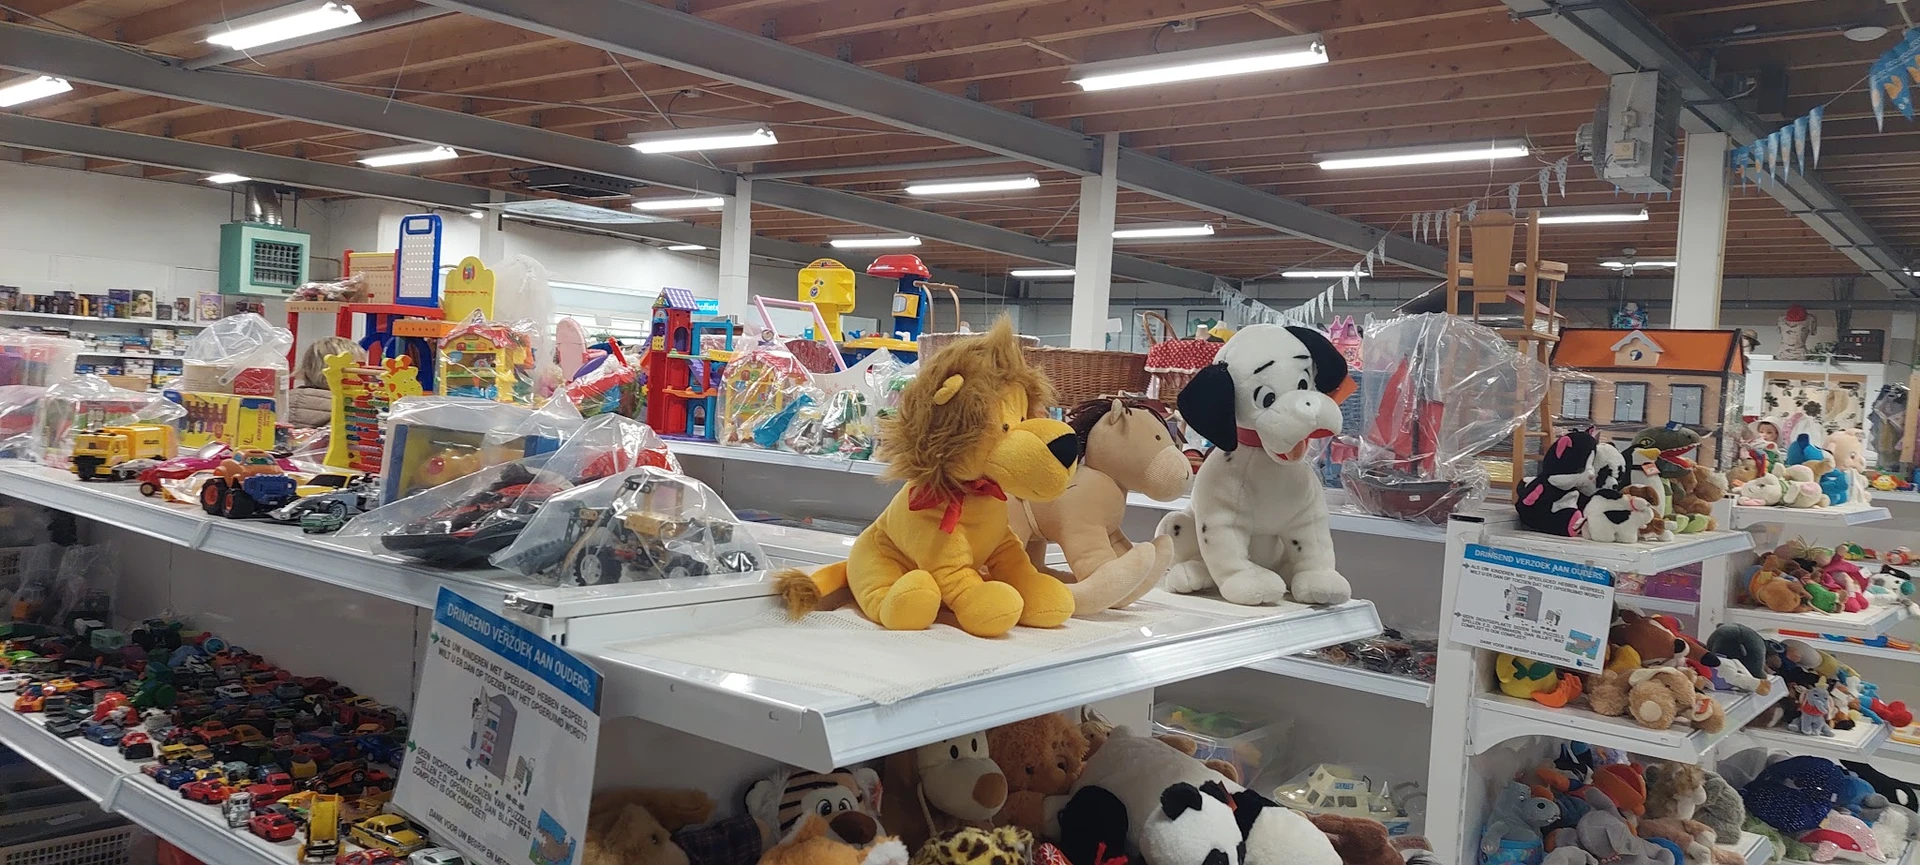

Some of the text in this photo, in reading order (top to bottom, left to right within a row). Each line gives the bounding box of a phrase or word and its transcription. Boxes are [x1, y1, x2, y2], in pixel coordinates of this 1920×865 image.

[1474, 549, 1513, 562] DRINGEND
[1514, 557, 1551, 569] VERZOEK
[1552, 564, 1569, 573] AAN
[440, 634, 451, 648] ALS
[451, 641, 461, 654] UW
[461, 646, 489, 670] KINDEREN
[489, 662, 502, 677] MET
[502, 669, 535, 697] SPEELGOED
[536, 689, 559, 711] HEBBEN
[446, 601, 491, 637] DRINGEND
[490, 624, 533, 659] VERZOEK
[533, 647, 554, 671] AAN
[437, 645, 587, 744] WILT U ER DAN OP TOEZIEN DAT HET OPGERUIMD WORDT?
[412, 763, 439, 790] COMPLEET
[438, 781, 445, 793] IS
[445, 786, 457, 801] OOK
[414, 754, 437, 777] SPELLEN
[484, 801, 496, 817] DAN
[517, 824, 531, 842] WAT
[416, 745, 533, 832] GEEN DICHTGEPLAKTE DOZEN VAN PUZZELS,
[428, 806, 443, 825] DANK
[443, 817, 457, 835] VOOR
[457, 827, 467, 842] UW
[466, 833, 486, 856] BEGRIP
[485, 847, 494, 861] EN
